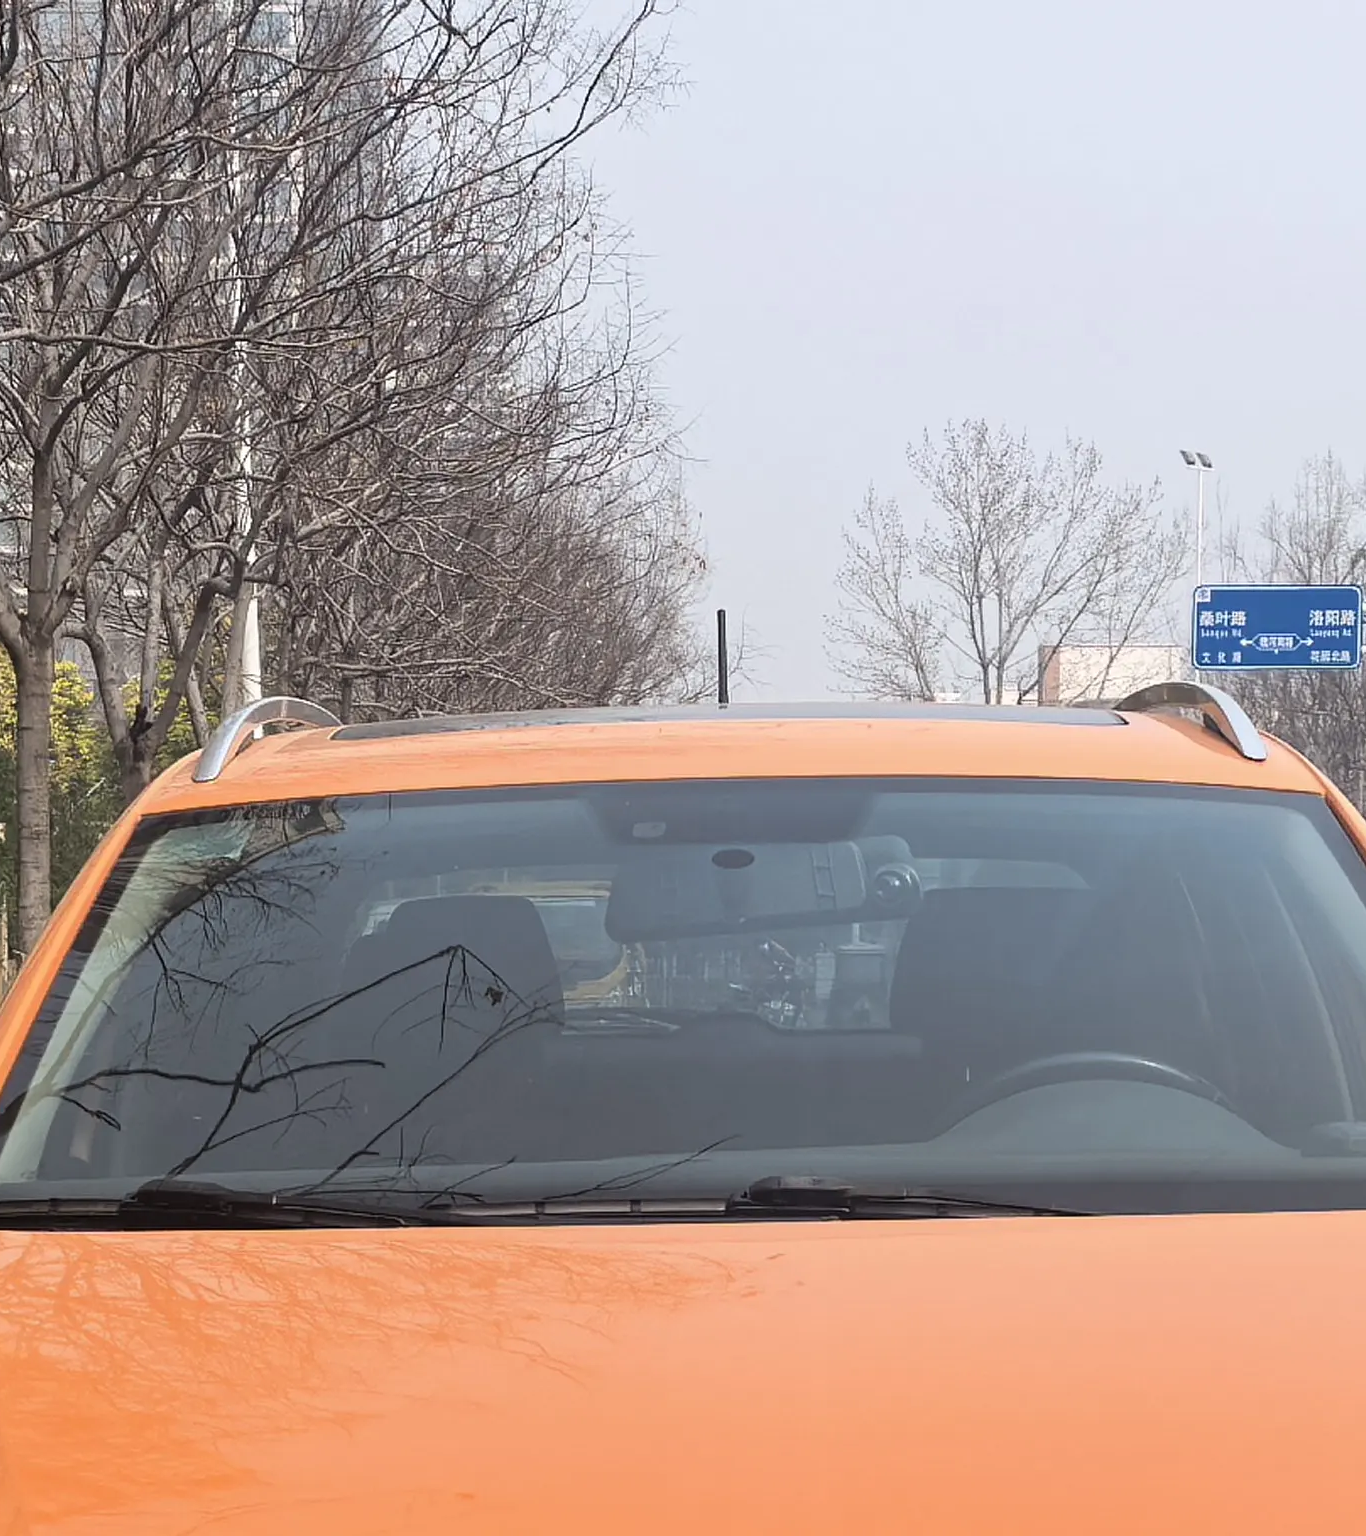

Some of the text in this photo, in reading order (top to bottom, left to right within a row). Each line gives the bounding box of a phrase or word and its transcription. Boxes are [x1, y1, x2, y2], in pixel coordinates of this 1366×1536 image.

[1199, 610, 1247, 627] 桑叶路
[1309, 609, 1357, 627] 洛阳路
